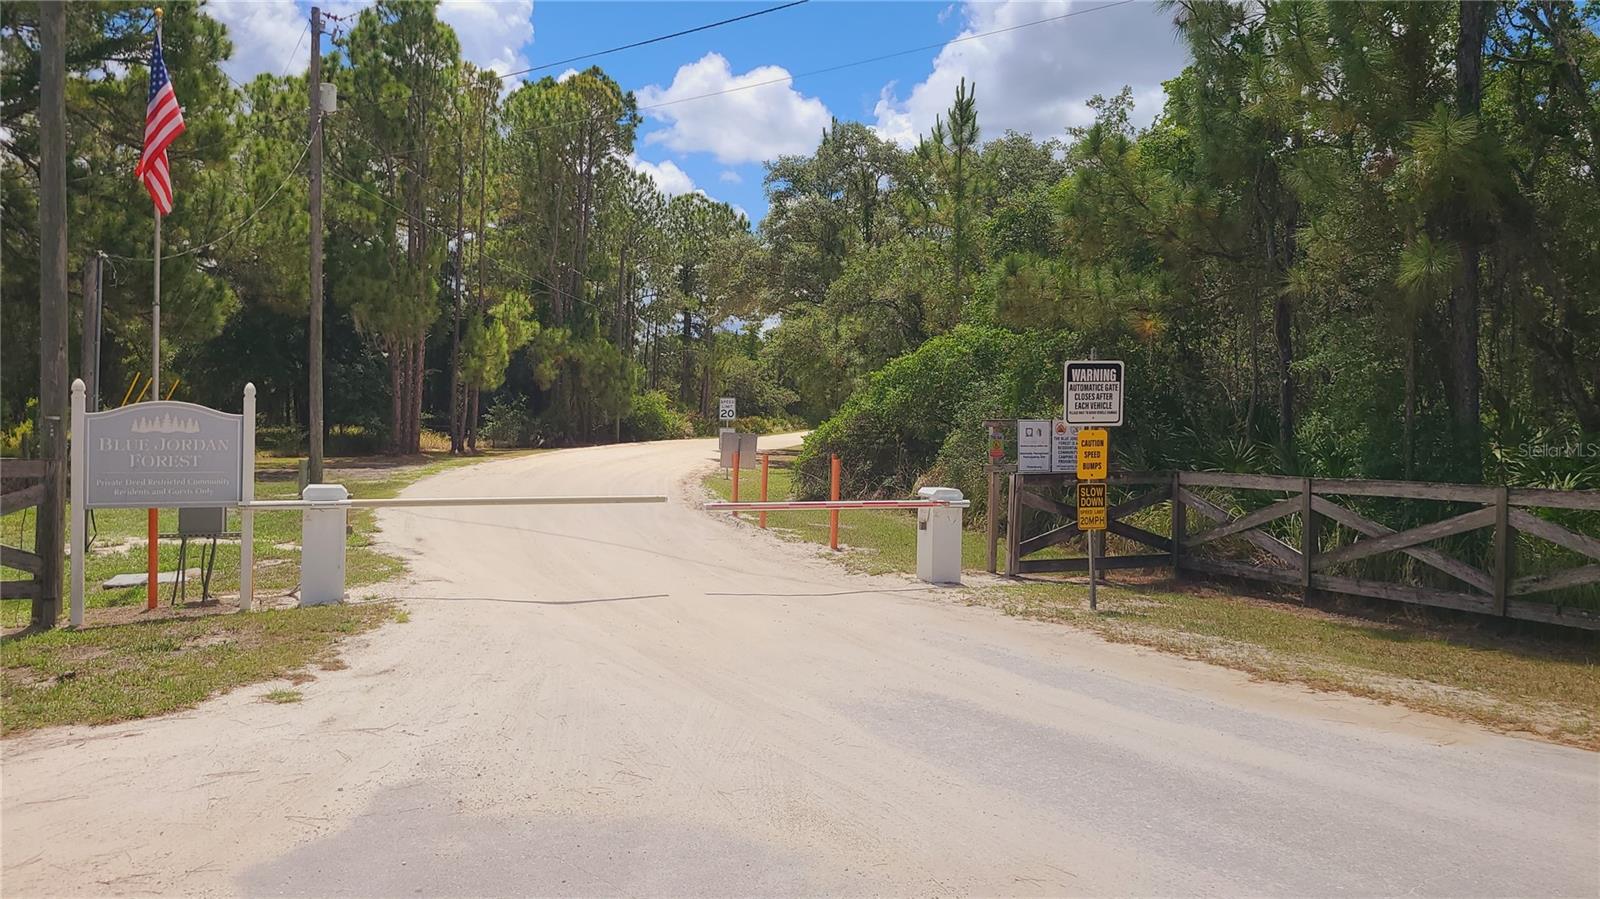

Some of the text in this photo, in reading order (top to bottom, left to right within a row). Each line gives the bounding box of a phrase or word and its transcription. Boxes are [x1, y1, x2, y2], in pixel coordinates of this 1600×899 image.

[1071, 368, 1117, 382] WARNING
[1069, 383, 1118, 391] AUTOMATICE GATE
[720, 409, 734, 418] 20
[100, 437, 229, 450] BLUE JORDAN
[129, 453, 202, 467] FOREST
[1082, 462, 1102, 470] BUMPS
[96, 478, 230, 487] Private Deed Restricted Community
[114, 487, 213, 497] Residents and Guests Only
[1080, 487, 1104, 497] SLOW
[1080, 497, 1104, 507] DOWN
[1080, 516, 1104, 525] 20MPH
